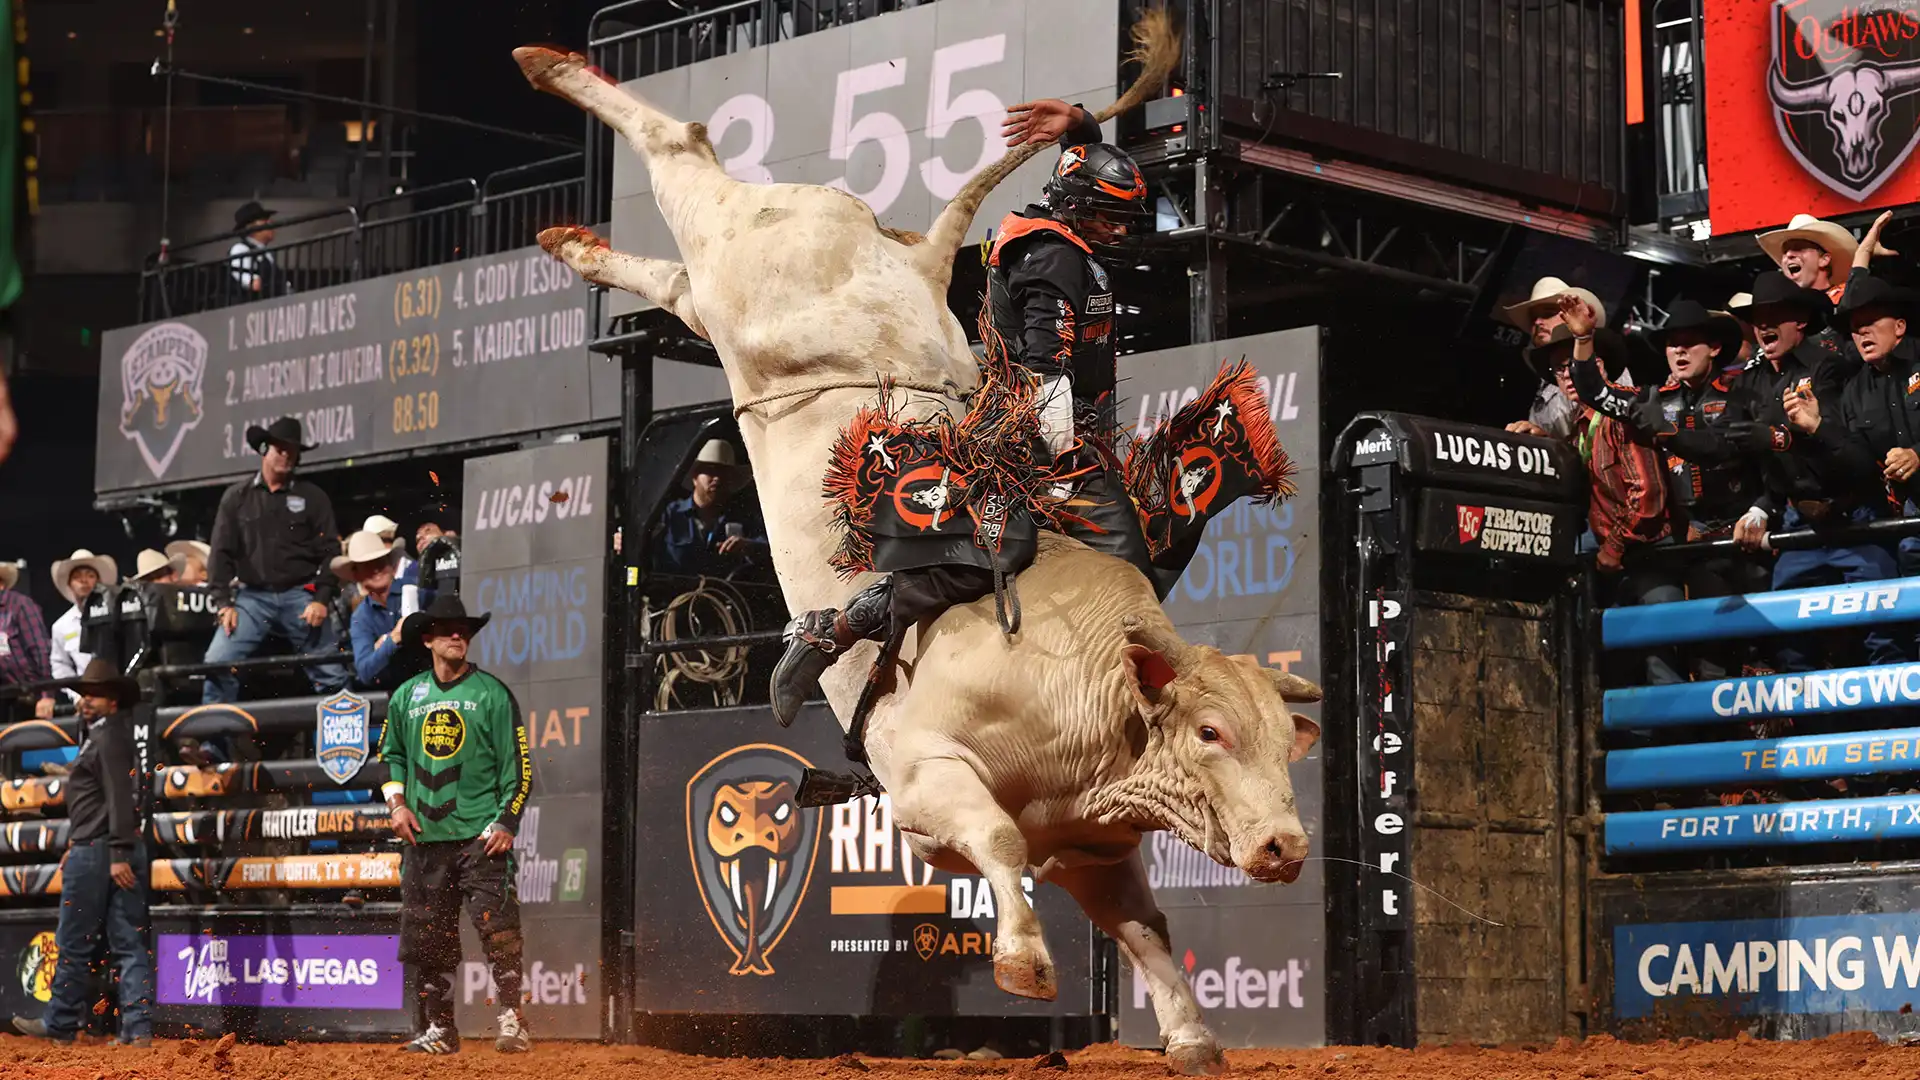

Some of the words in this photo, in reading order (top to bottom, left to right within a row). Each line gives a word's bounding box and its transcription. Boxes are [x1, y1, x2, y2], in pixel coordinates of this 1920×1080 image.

[453, 271, 468, 310] 4.
[474, 260, 519, 306] CODY
[522, 255, 573, 297] JESUS
[228, 316, 238, 350] 1.
[245, 303, 306, 348] SILVANO
[309, 293, 357, 336] ALVES
[394, 275, 442, 326] (6.31)
[453, 329, 468, 367] 5.
[473, 316, 536, 364] KAIDEN
[540, 307, 585, 352] LOUD
[225, 370, 239, 405] 2.
[242, 358, 306, 402] ANDERSON
[308, 353, 324, 391] DE
[327, 343, 383, 388] OLIVEIRA
[389, 332, 440, 384] (3.32)
[223, 424, 236, 458] 3.
[305, 404, 355, 446] SOUZA
[393, 390, 440, 434] 88.50
[1356, 434, 1392, 455] Merit
[1433, 432, 1512, 470] LUCAS
[1517, 445, 1556, 477] OIL
[475, 480, 552, 531] LUCAS
[556, 475, 593, 520] OIL
[1208, 498, 1294, 537] PING
[988, 523, 1001, 546] BOY
[1459, 505, 1479, 538] TSC
[1484, 506, 1554, 535] TRACTOR
[1481, 530, 1534, 554] SUPPLY
[1168, 534, 1295, 603] ORLD
[176, 591, 218, 614] LUC
[478, 566, 587, 614] CAMPING
[1797, 587, 1900, 619] PBR
[480, 611, 587, 667] WORLD
[408, 700, 460, 719] PROTECTED
[464, 700, 478, 711] BY
[1712, 671, 1861, 717] CAMPING
[323, 727, 363, 745] WORLD
[425, 725, 458, 737] BORDER
[425, 735, 456, 748] PATROL
[515, 726, 530, 756] TEAM
[529, 706, 590, 749] IAT
[1369, 600, 1404, 915] Priefert
[1741, 745, 1829, 771] TEAM
[262, 808, 317, 840] RATTLER
[317, 810, 355, 833] DAYS
[1661, 815, 1740, 839] FORT
[1752, 807, 1871, 834] WORTH,
[242, 863, 271, 882] FORT
[325, 862, 340, 881] TX
[359, 859, 393, 880] 2024
[564, 858, 582, 892] 25
[830, 939, 890, 952] PRESENTED
[895, 939, 909, 952] BY
[940, 932, 991, 955] ARI
[244, 958, 289, 985] LAS
[292, 958, 378, 985] VEGAS
[1638, 936, 1865, 997] CAMPING
